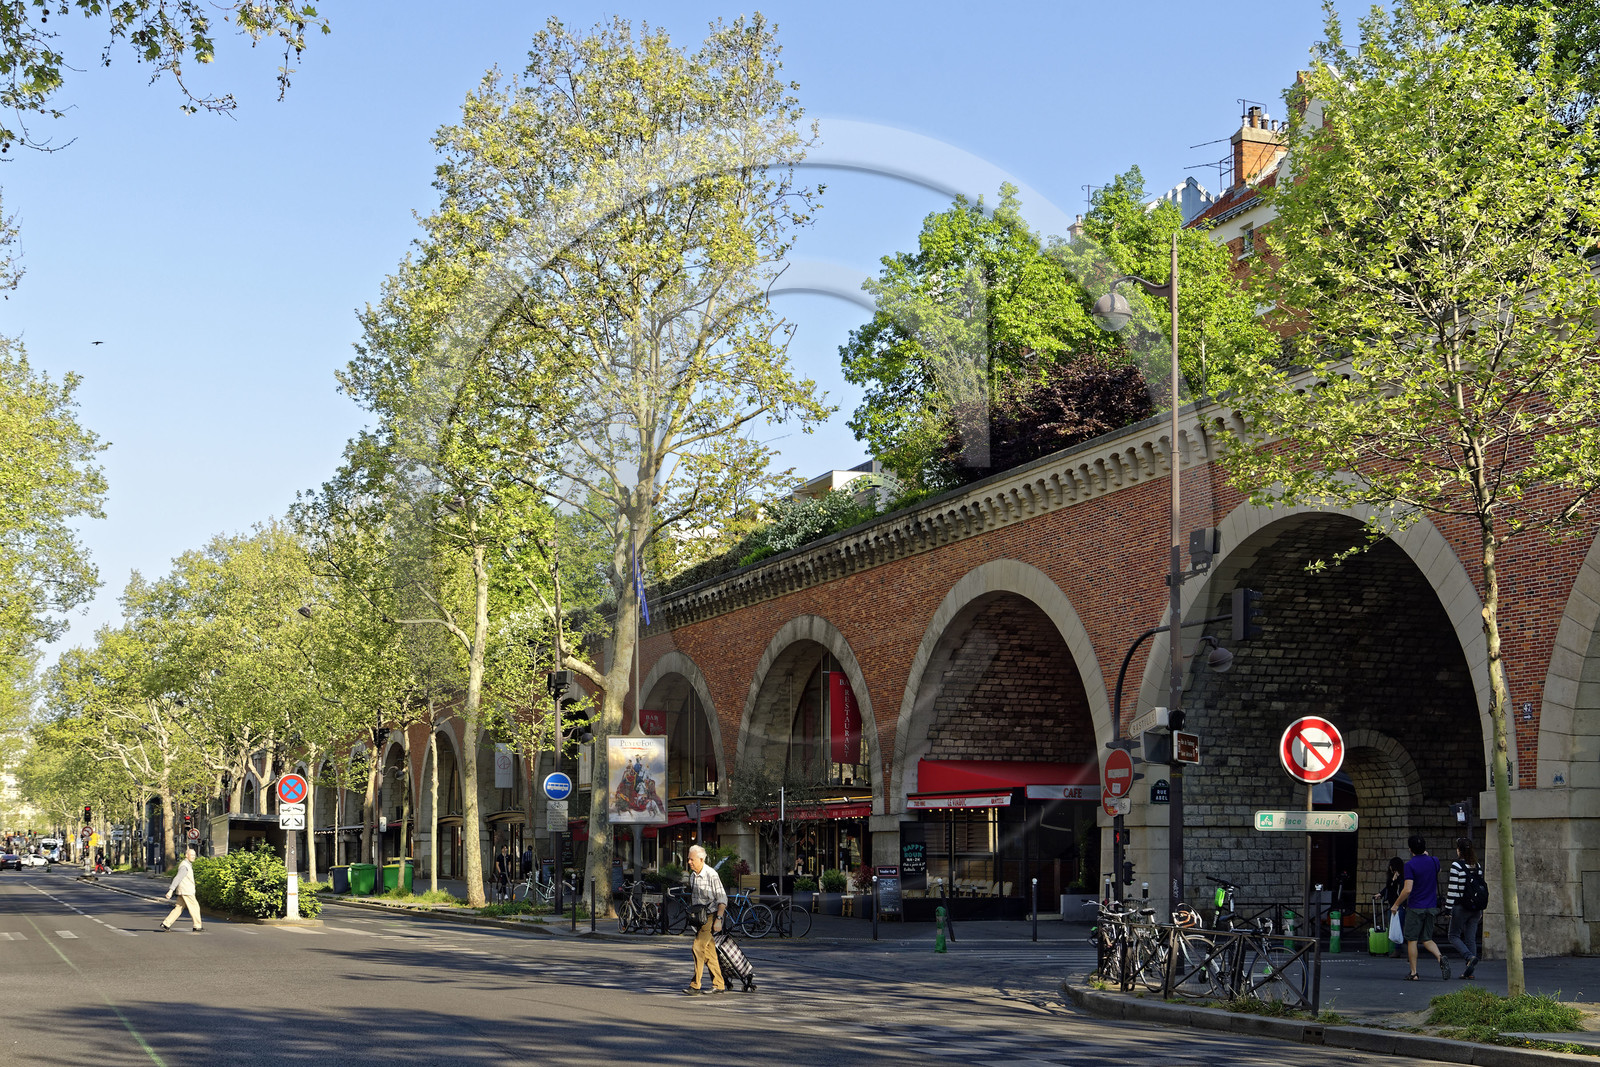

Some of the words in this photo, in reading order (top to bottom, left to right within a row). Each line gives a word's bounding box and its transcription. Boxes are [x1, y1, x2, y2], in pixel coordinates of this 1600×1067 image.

[1132, 713, 1156, 734] BASTILLE
[1279, 817, 1302, 825] Place
[902, 844, 924, 852] HAPPY
